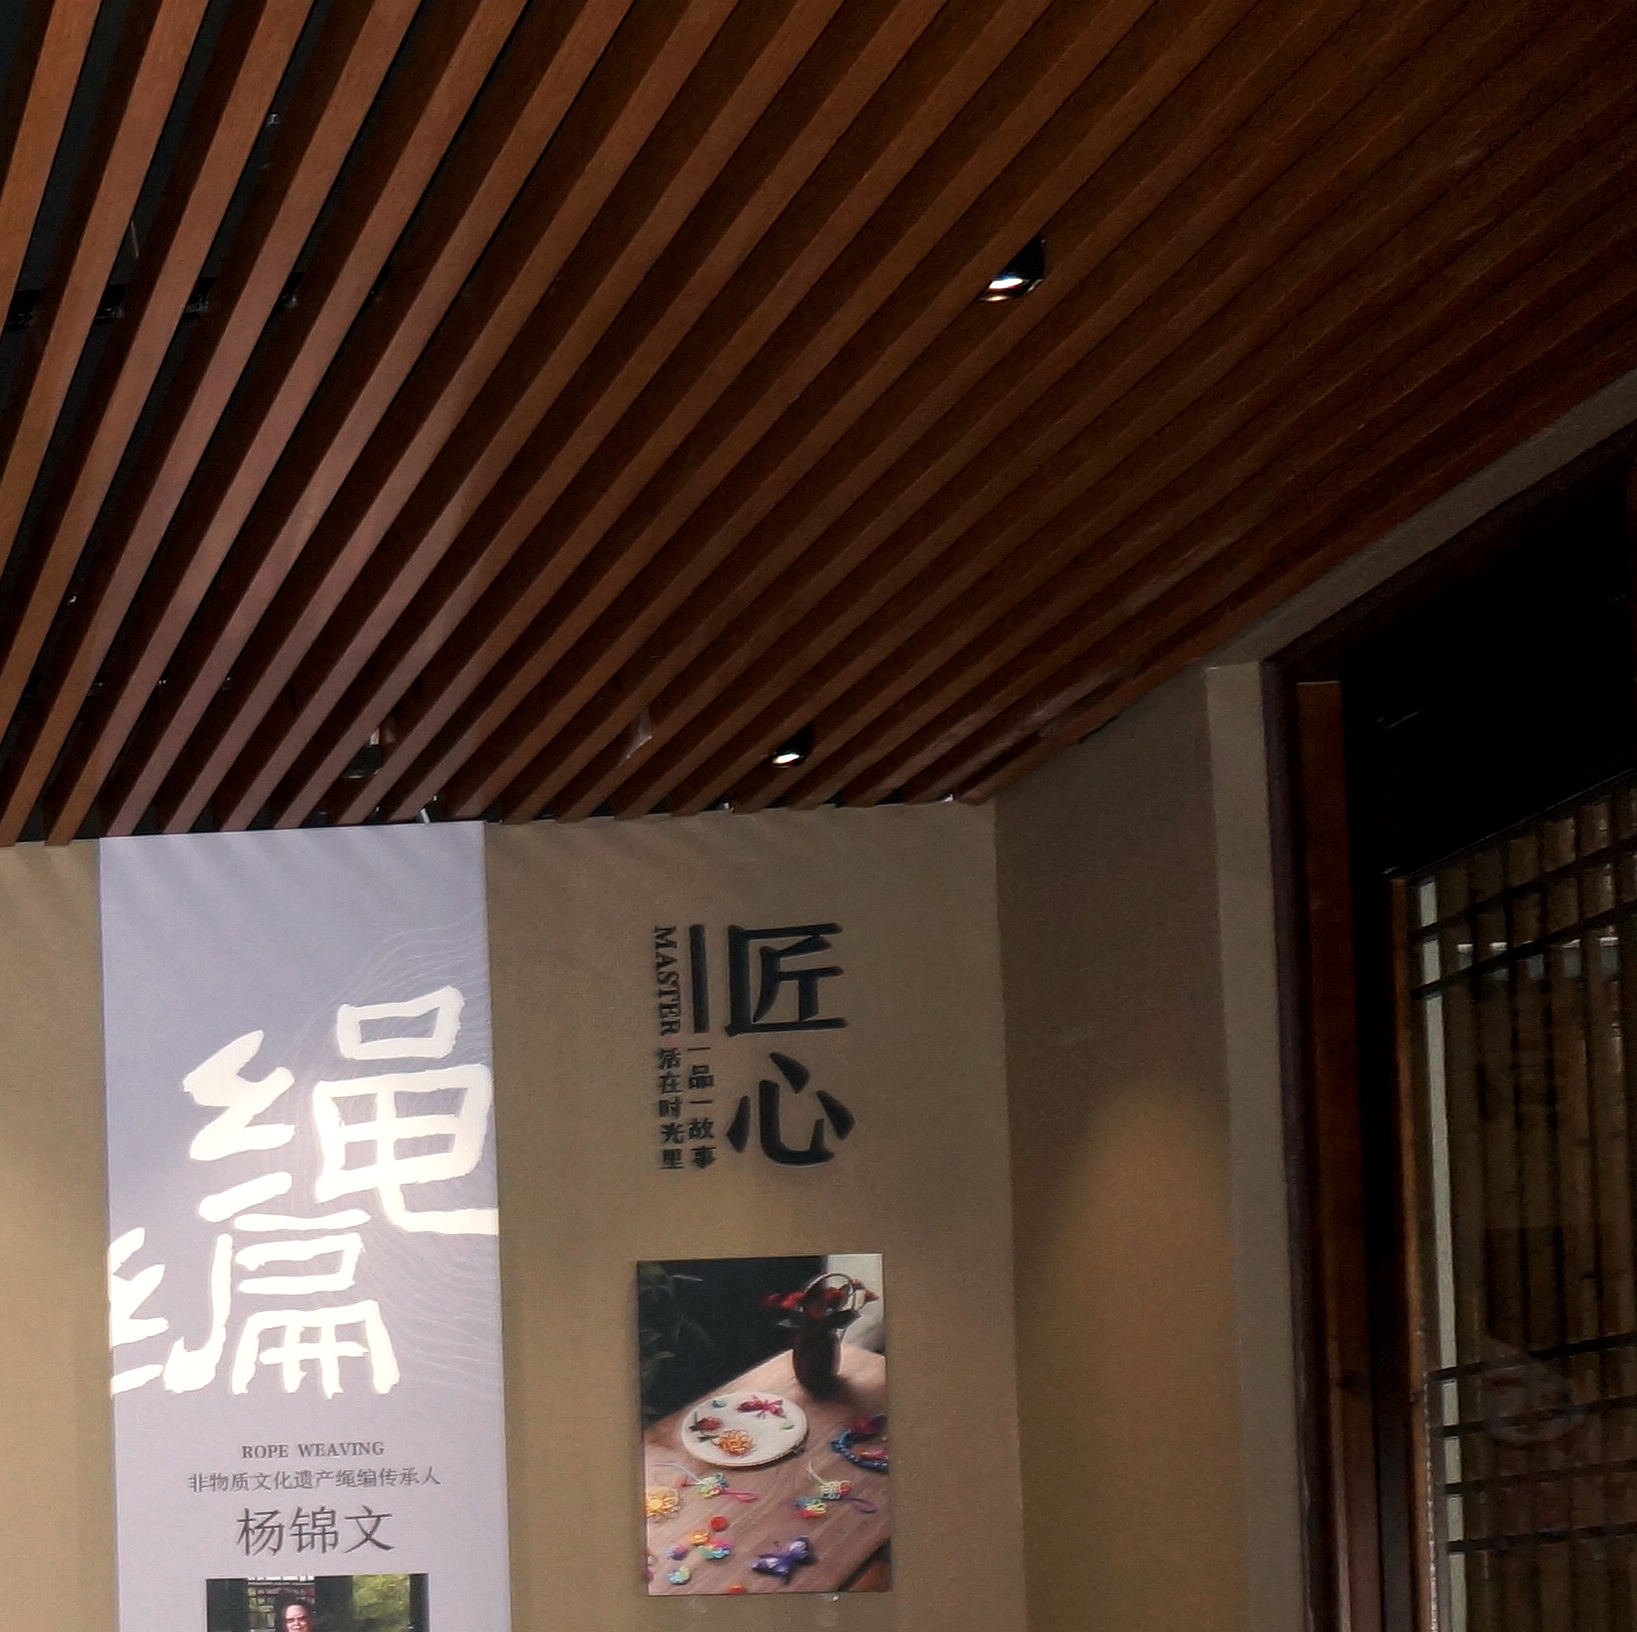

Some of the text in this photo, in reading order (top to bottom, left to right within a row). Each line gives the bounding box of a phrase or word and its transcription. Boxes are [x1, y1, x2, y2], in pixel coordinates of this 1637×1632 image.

[653, 925, 682, 1037] MASTER
[725, 922, 855, 1165] 匠心
[687, 1047, 717, 1169] 一品一故事
[187, 1465, 441, 1493] 非物质文化遗产绳编传承人
[241, 1441, 385, 1460] ROPE WEAVING
[236, 1504, 396, 1557] 杨锦文
